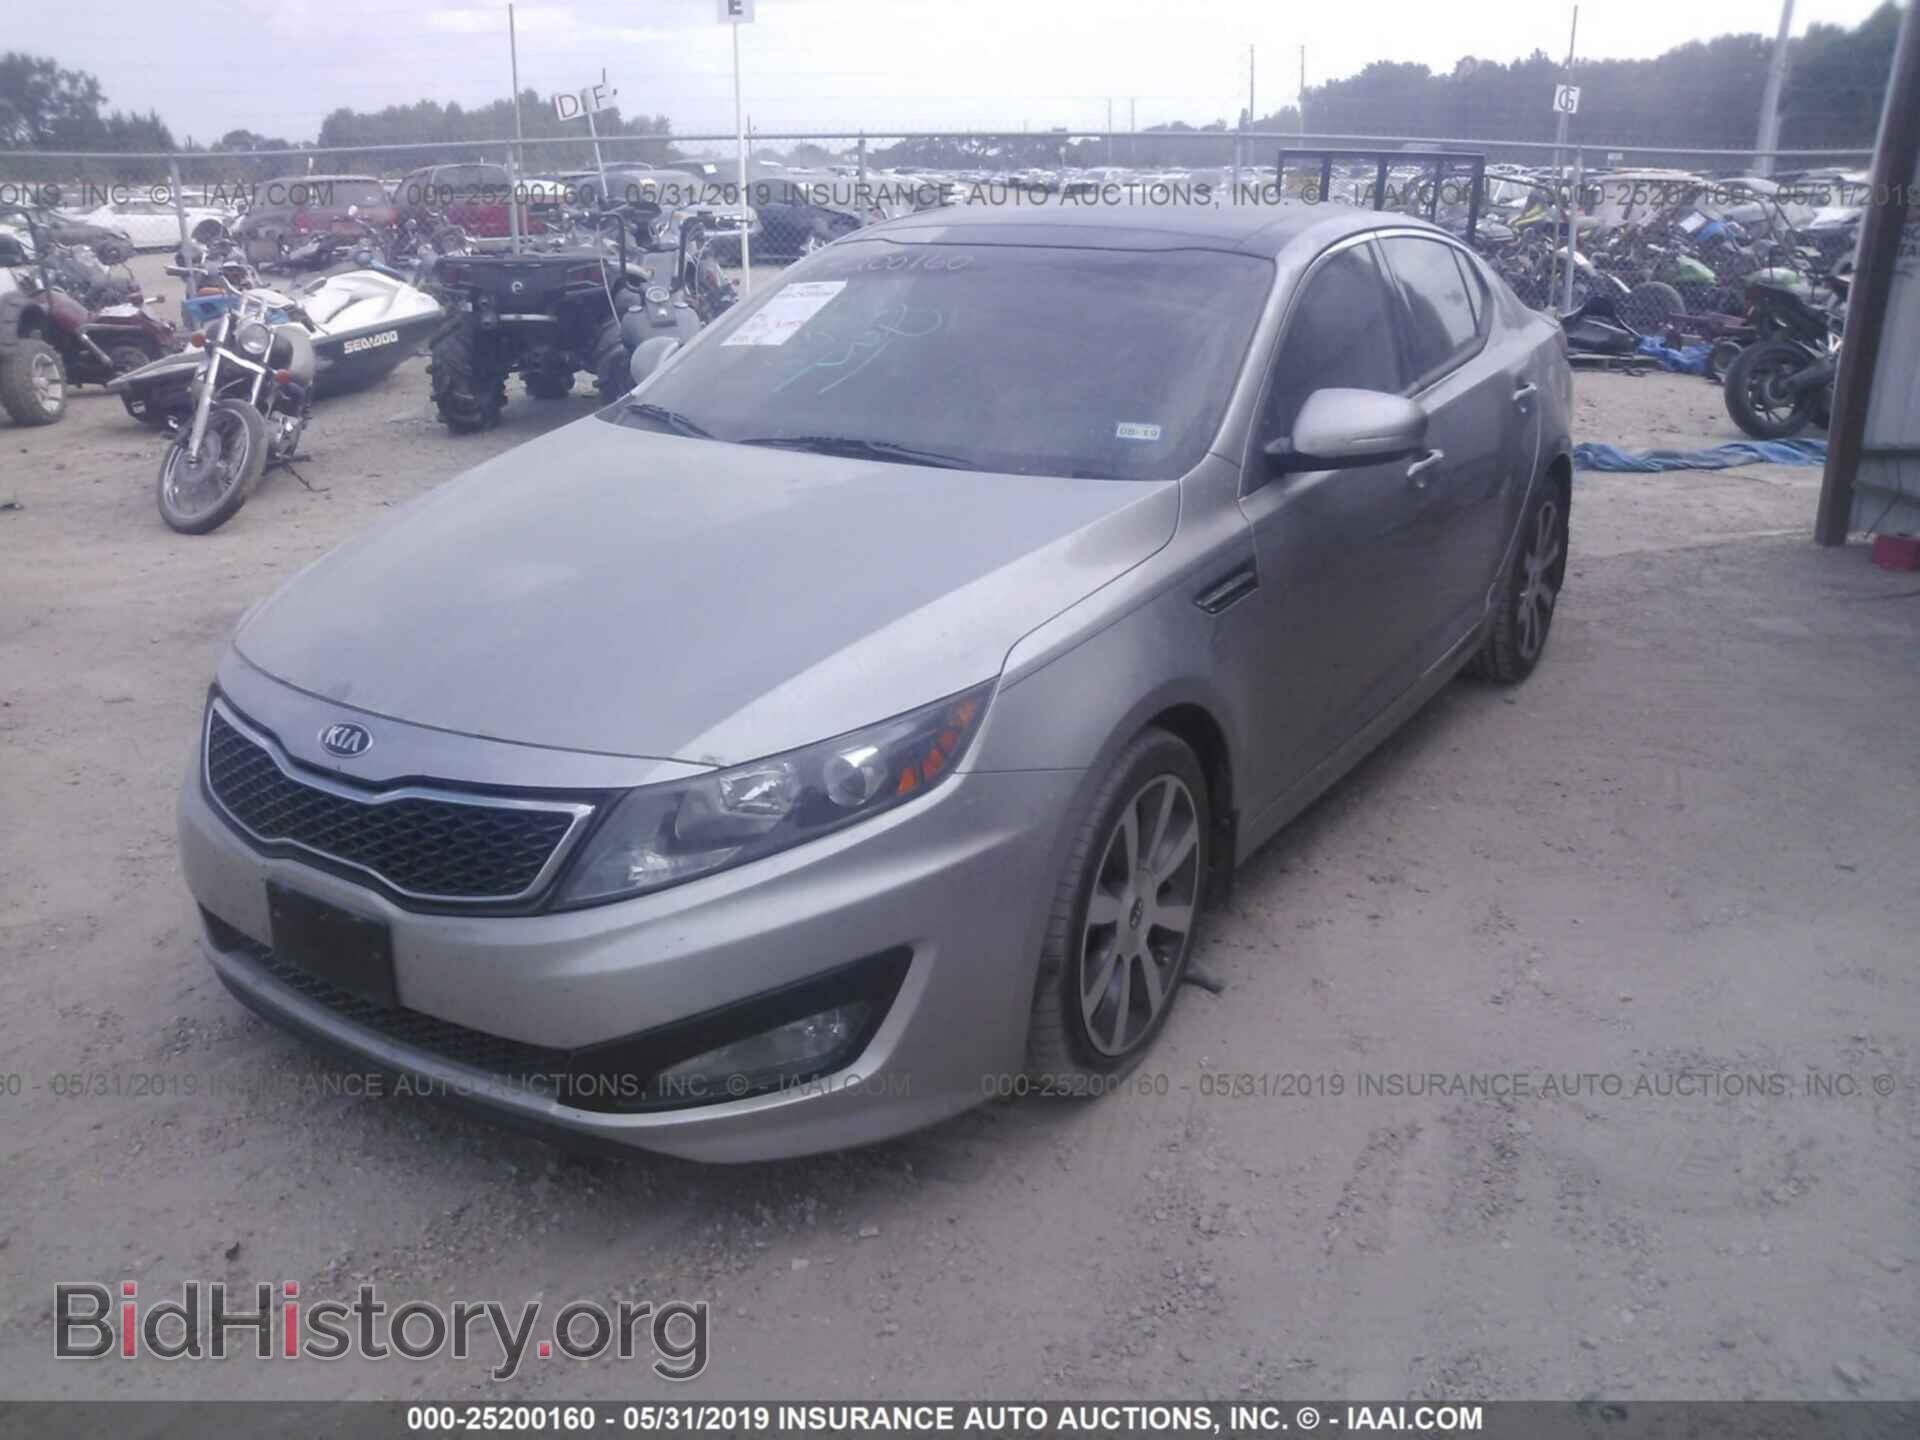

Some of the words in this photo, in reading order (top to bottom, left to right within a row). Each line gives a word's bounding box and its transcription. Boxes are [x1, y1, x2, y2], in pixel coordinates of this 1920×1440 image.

[559, 94, 579, 118] D
[1558, 88, 1575, 112] G
[325, 726, 361, 752] KIA
